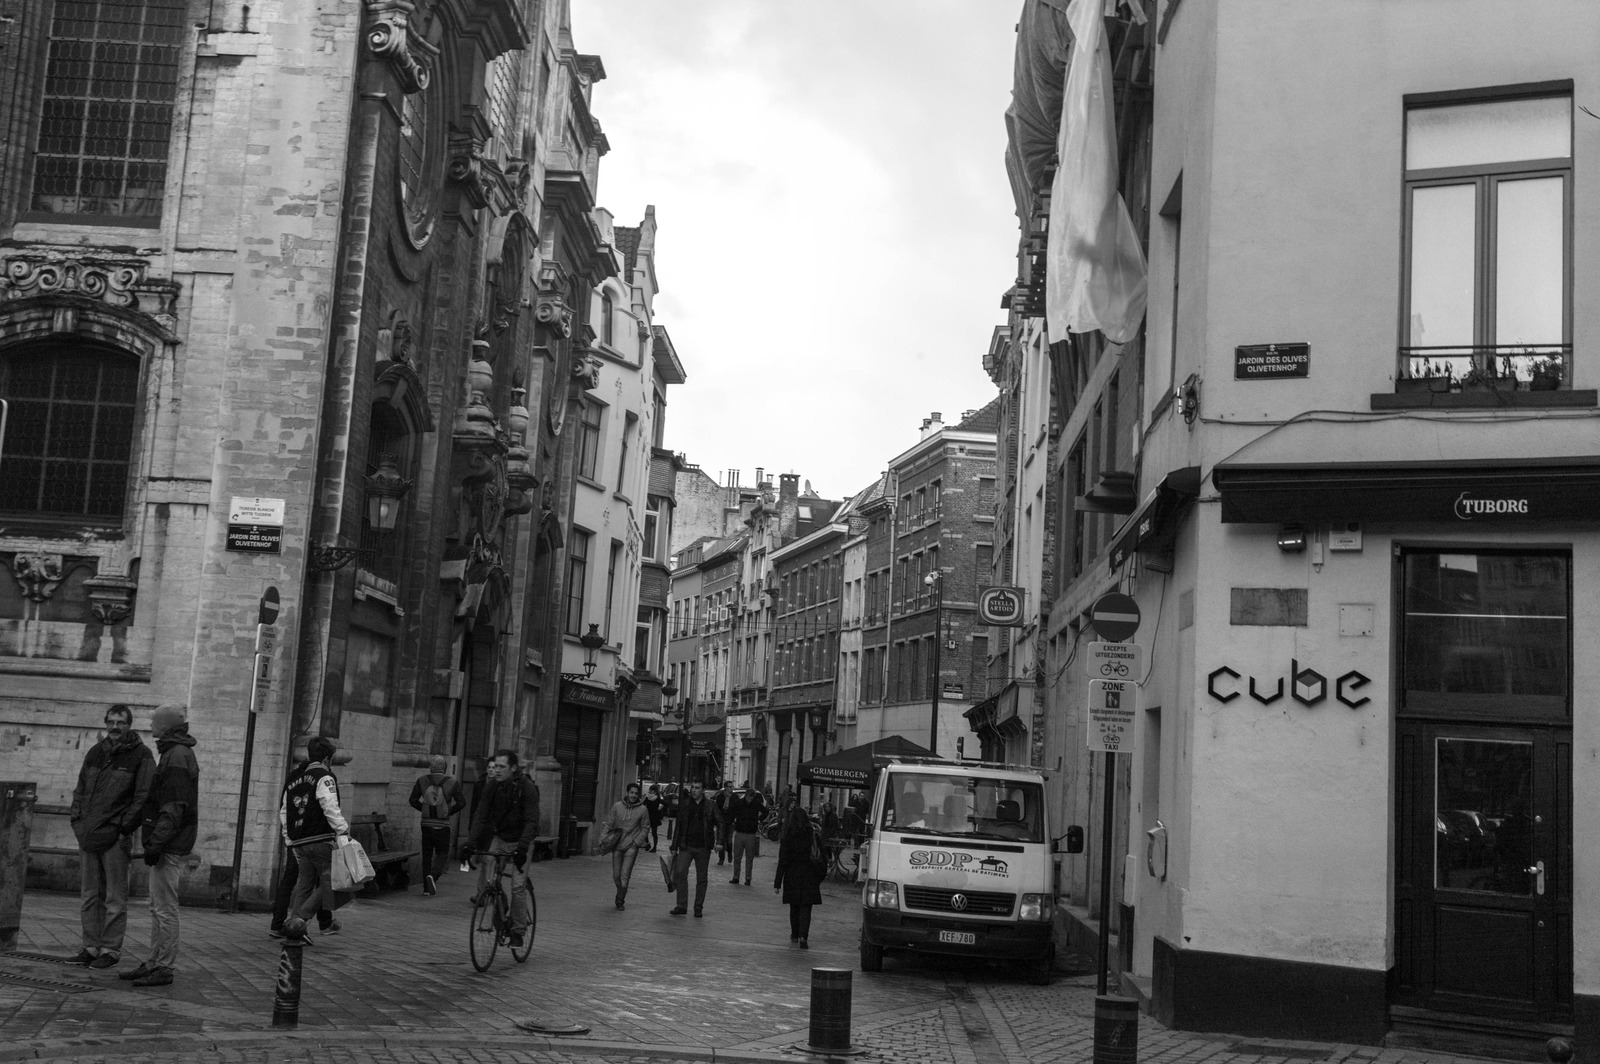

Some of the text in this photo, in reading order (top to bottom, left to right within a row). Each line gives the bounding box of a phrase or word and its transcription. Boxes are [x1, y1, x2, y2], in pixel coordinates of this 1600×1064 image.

[1247, 364, 1297, 372] OLIVETENHOF
[1462, 499, 1528, 513] TUBORG
[1102, 682, 1125, 691] ZONE
[1208, 658, 1371, 709] cube
[813, 767, 865, 778] GRIMBERGEN
[909, 850, 973, 867] SDP
[980, 870, 1010, 879] BATIMENT
[942, 932, 973, 943] XEF-780
